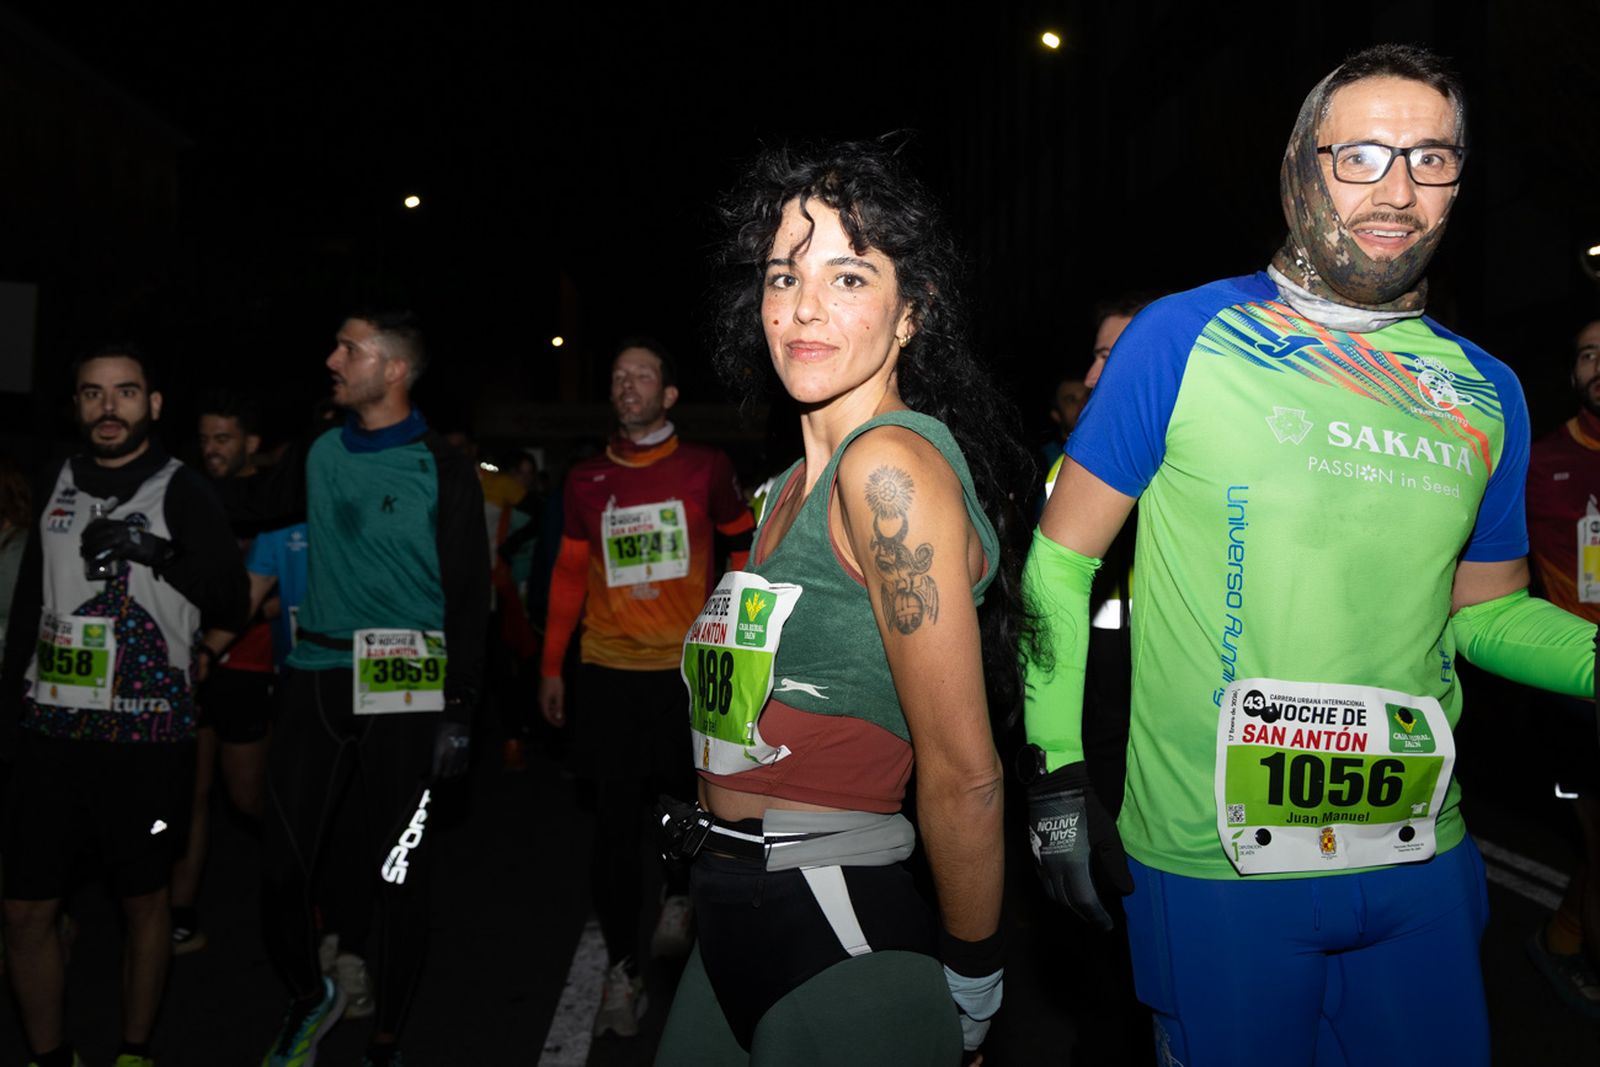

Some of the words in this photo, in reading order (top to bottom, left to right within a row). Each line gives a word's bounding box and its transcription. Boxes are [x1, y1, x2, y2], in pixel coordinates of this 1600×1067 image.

[1327, 421, 1473, 476] SAKATA
[1401, 473, 1417, 488] in
[1423, 476, 1460, 498] Seed
[1226, 485, 1249, 609] Universo
[373, 657, 440, 684] 3859
[1243, 696, 1265, 710] 43
[1270, 693, 1296, 703] CARRERA
[1322, 698, 1366, 707] INTERNACIONAL
[1342, 708, 1367, 726] DE
[1242, 723, 1287, 746] SAN
[1290, 726, 1368, 753] ANTÓN
[1260, 752, 1406, 809] 1056
[1037, 815, 1080, 835] ANTÓN
[1286, 811, 1318, 824] Juan
[1322, 811, 1370, 823] Manuel
[381, 788, 432, 885] SPORT
[1049, 827, 1078, 841] SAN
